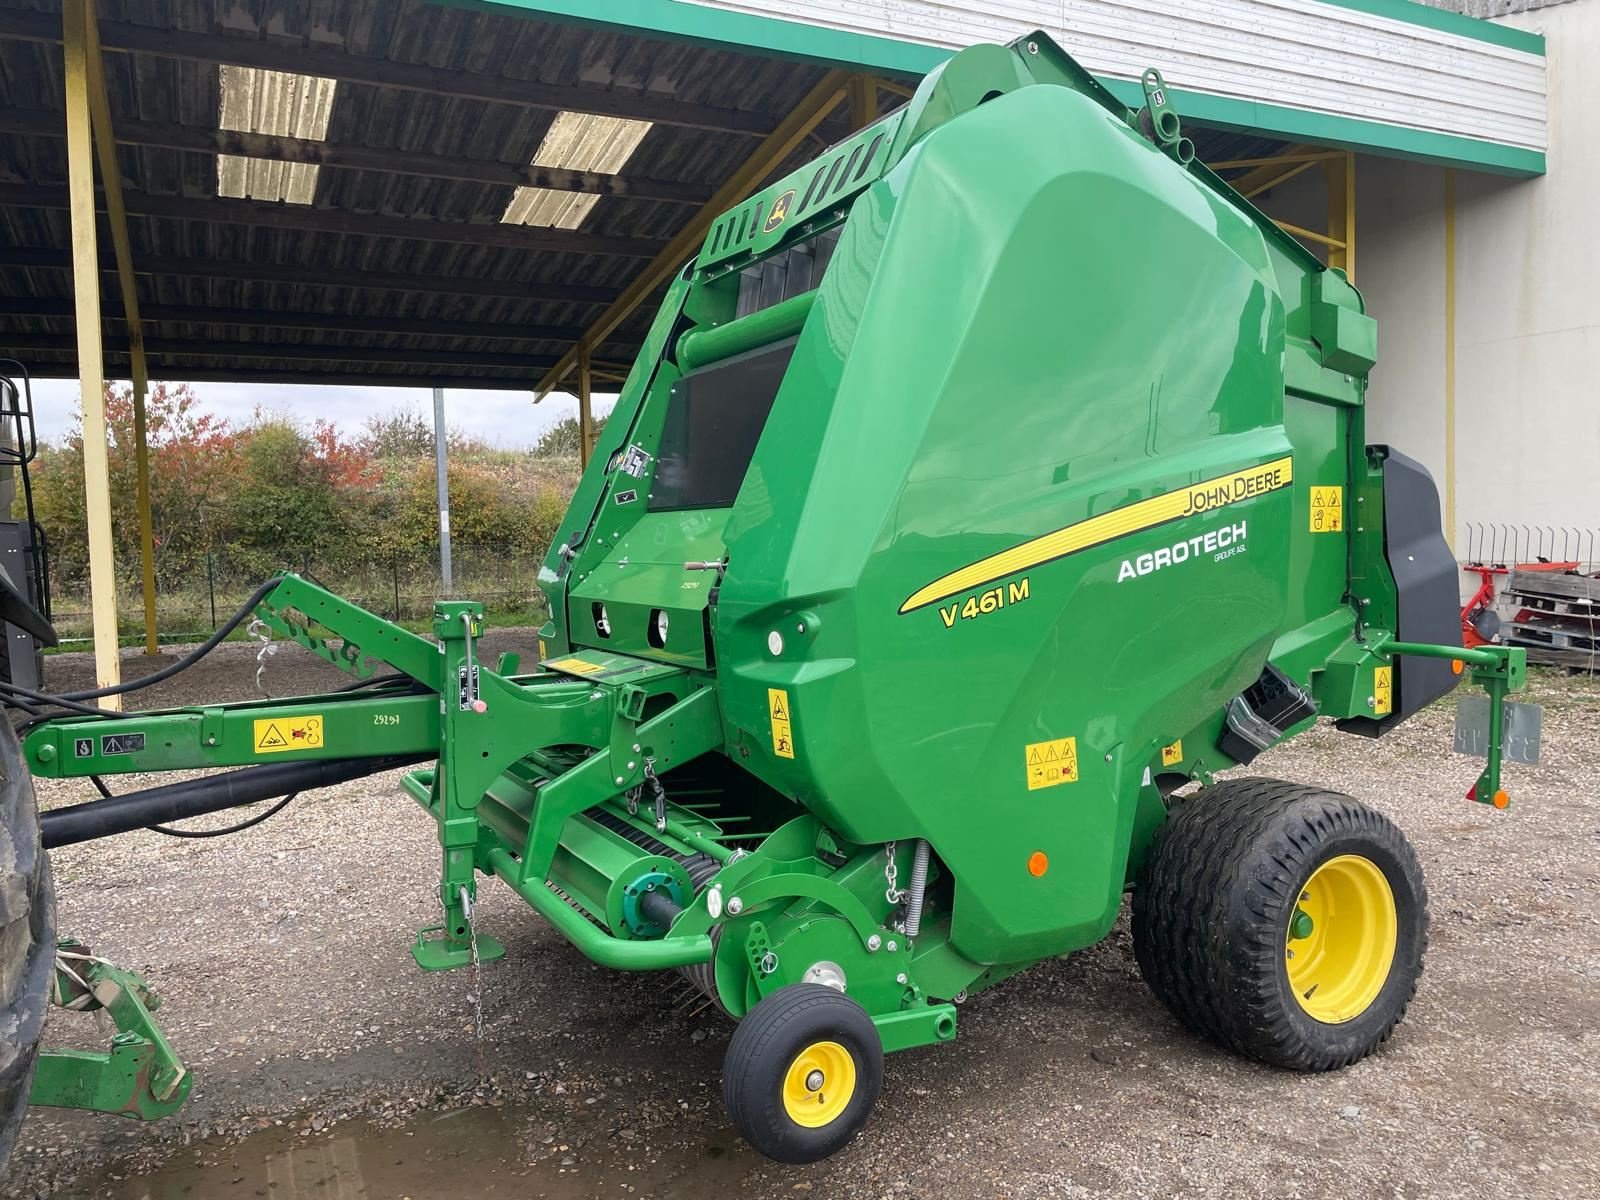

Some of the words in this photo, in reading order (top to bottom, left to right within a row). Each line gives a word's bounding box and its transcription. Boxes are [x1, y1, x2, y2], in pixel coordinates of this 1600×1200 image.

[1183, 484, 1230, 514] JOHN
[1234, 469, 1282, 499] DEERE
[1117, 520, 1247, 583] AGROTECH
[1214, 547, 1236, 562] GROUPE
[939, 602, 959, 628] V
[961, 586, 1005, 620] 461
[1008, 577, 1030, 605] M
